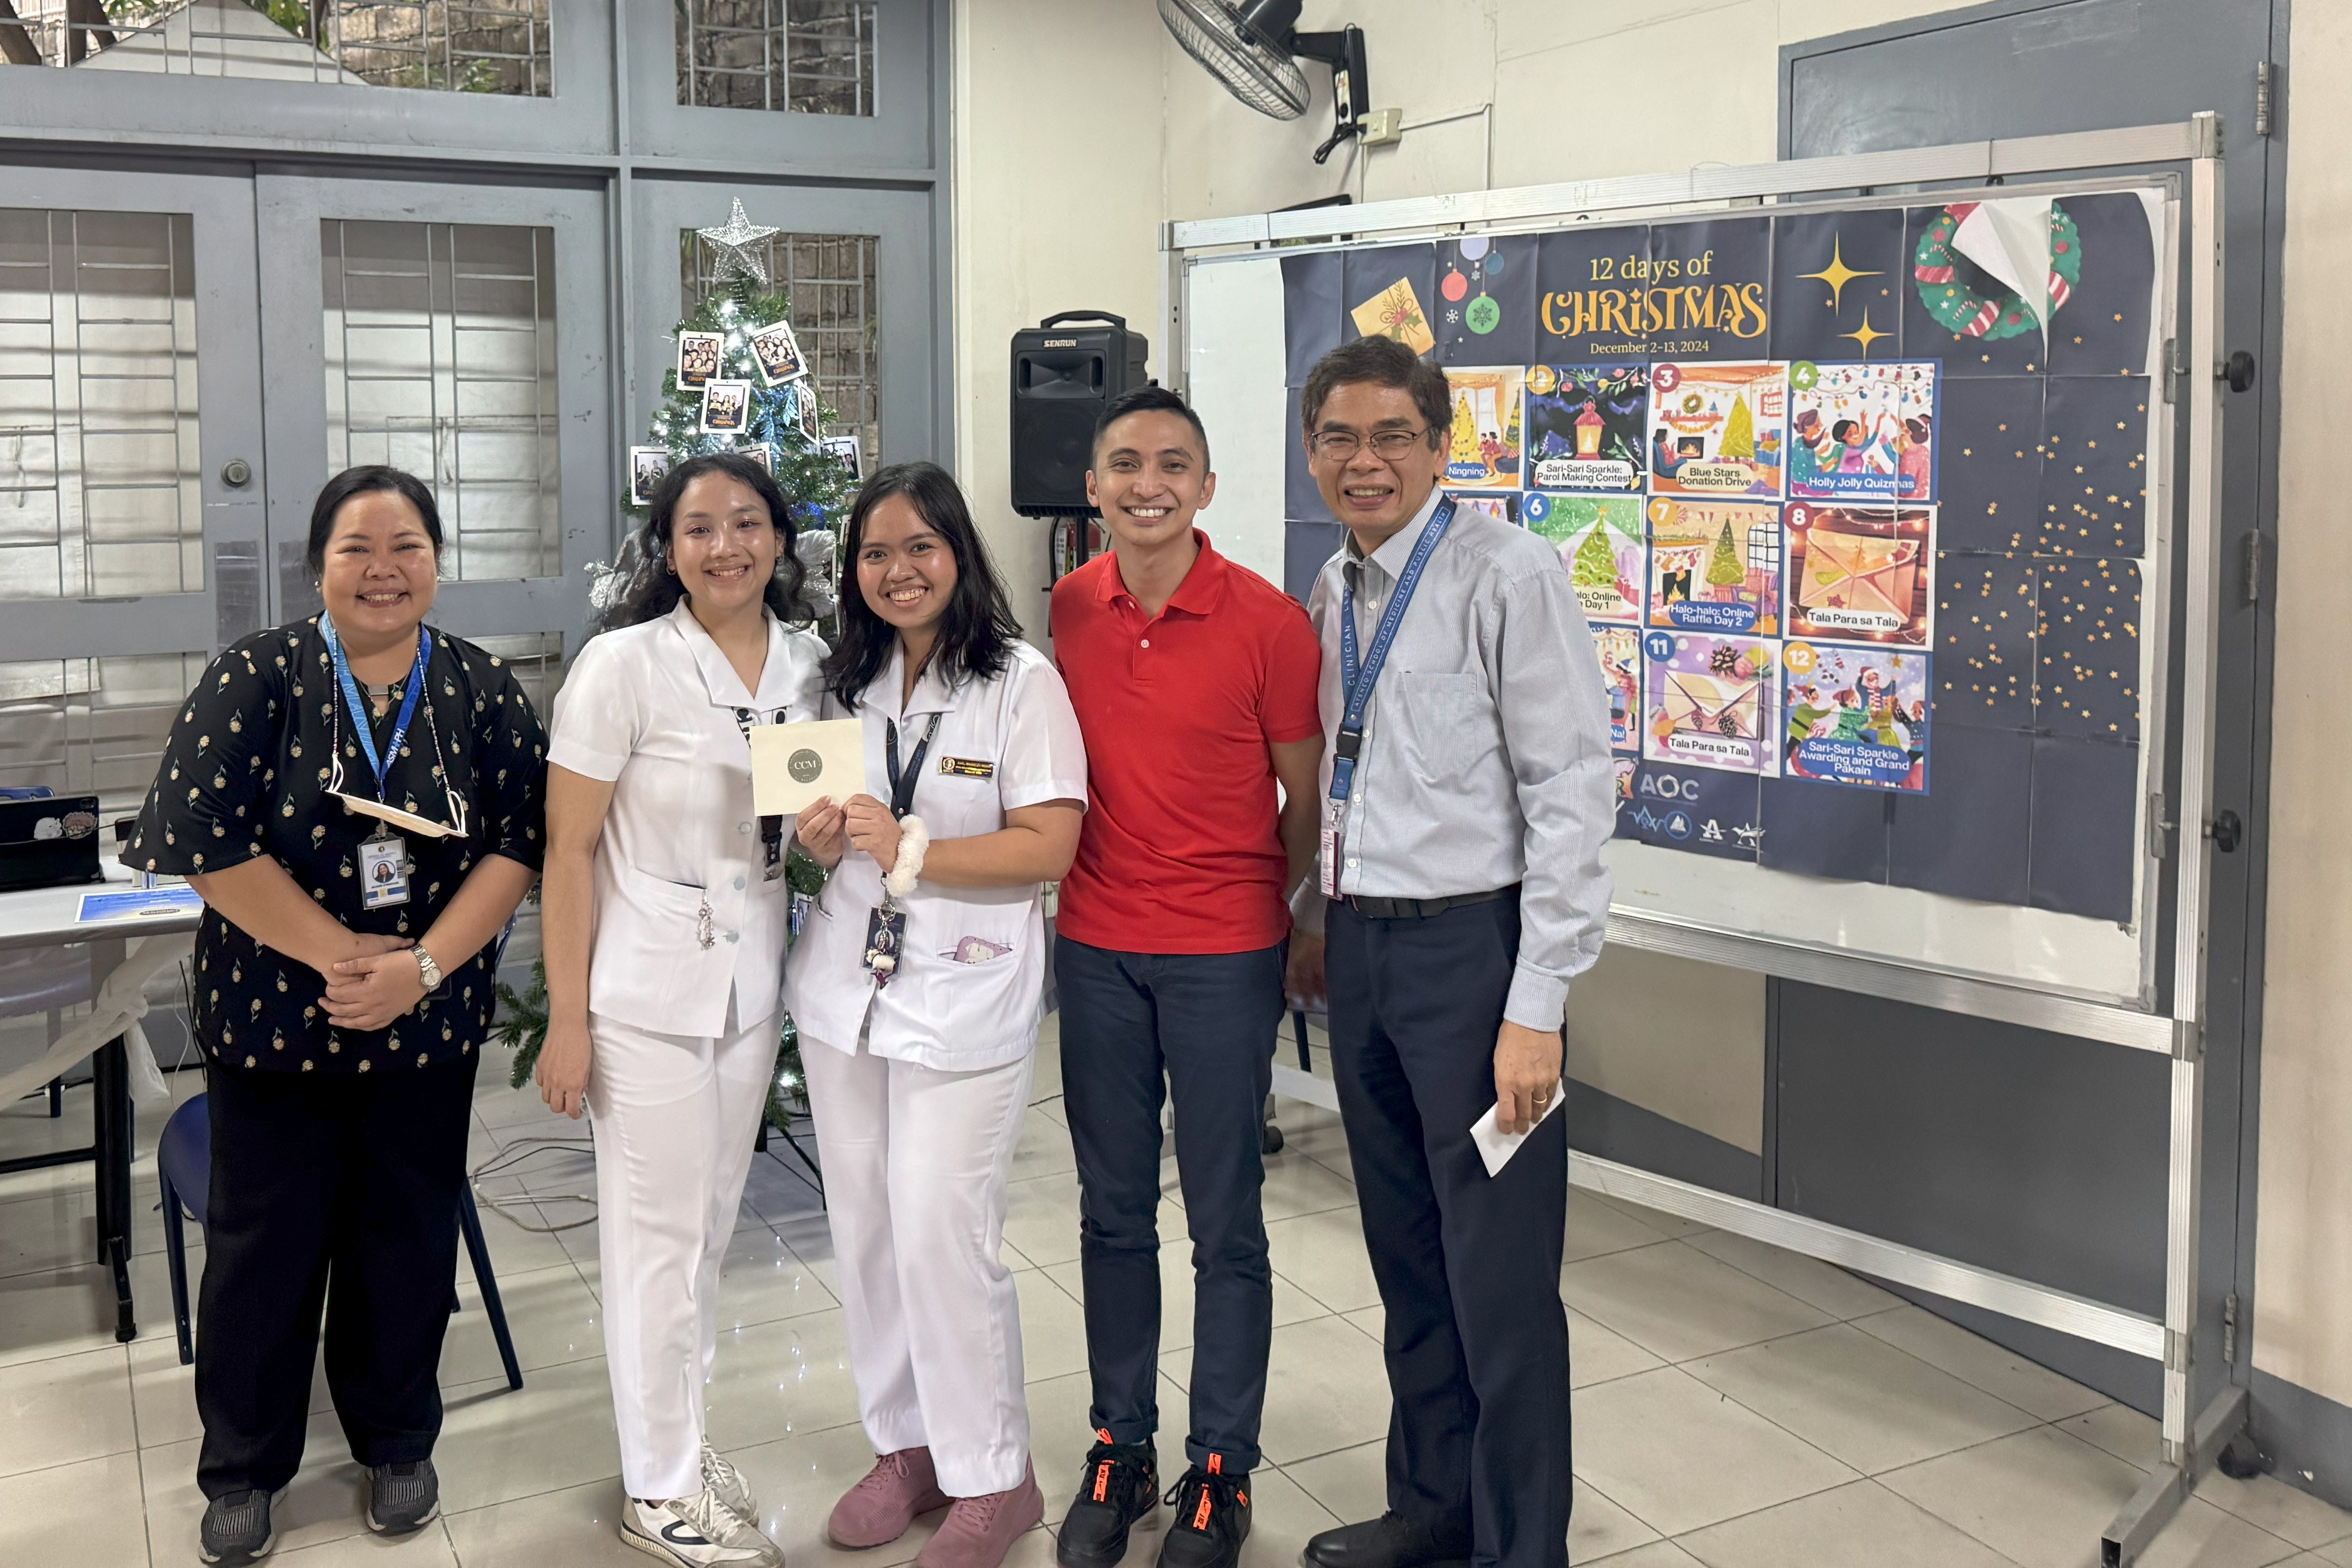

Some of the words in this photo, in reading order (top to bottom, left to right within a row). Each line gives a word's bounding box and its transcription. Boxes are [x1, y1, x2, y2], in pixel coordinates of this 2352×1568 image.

[1590, 257, 1613, 281] 12
[1621, 254, 1680, 286] days
[1686, 250, 1714, 277] of
[1590, 341, 1647, 354] December
[1680, 340, 1709, 352] 2024
[1660, 370, 1673, 387] 3
[1796, 367, 1809, 384] 4
[1448, 466, 1485, 478] Ningning
[1537, 472, 1559, 482] Parol
[1561, 473, 1594, 483] Making
[1596, 474, 1632, 483] Contest
[1546, 464, 1584, 473] Sari-Sari
[1587, 464, 1623, 476] Sparkle:
[1689, 467, 1712, 477] Blue
[1714, 468, 1740, 477] Stars
[1678, 476, 1722, 486] Donation
[1725, 477, 1752, 486] Drive
[1809, 477, 1836, 489] Holly
[1838, 477, 1862, 490] Jolly
[1864, 478, 1915, 489] Quizmas
[1531, 498, 1543, 515] 6
[1657, 503, 1669, 520] 7
[1792, 508, 1806, 526] 8
[1367, 645, 1383, 674] SCHOOL
[1381, 630, 1388, 641] OF
[1386, 589, 1407, 628] MEDICINE
[1404, 570, 1415, 586] AND
[1413, 539, 1430, 567] PUBLIC
[1429, 512, 1446, 537] HEALTH
[1592, 591, 1622, 601] Online
[1585, 600, 1602, 610] Day
[1605, 601, 1609, 610] 1
[1670, 604, 1721, 616] Halo-halo:
[1722, 607, 1754, 618] Online
[1682, 614, 1712, 624] Raffle
[1714, 616, 1734, 627] Day
[1735, 618, 1743, 626] 2
[1809, 612, 1831, 622] Tala
[1833, 614, 1857, 624] Para
[1875, 616, 1898, 627] Tala
[1344, 624, 1355, 686] CLINICIAN
[1650, 639, 1668, 656] 11
[1789, 650, 1809, 666] 12
[1669, 738, 1690, 748] Tala
[1692, 741, 1714, 751] Para
[1730, 745, 1749, 756] Tala
[1808, 741, 1854, 755] Sari-Sari
[1856, 746, 1899, 760] Sparkle
[794, 760, 816, 770] CCM
[1799, 749, 1850, 766] Awarding
[1852, 757, 1873, 767] and
[1875, 758, 1910, 771] Grand
[1834, 763, 1871, 776] Pakain
[1640, 774, 1700, 800] AOC
